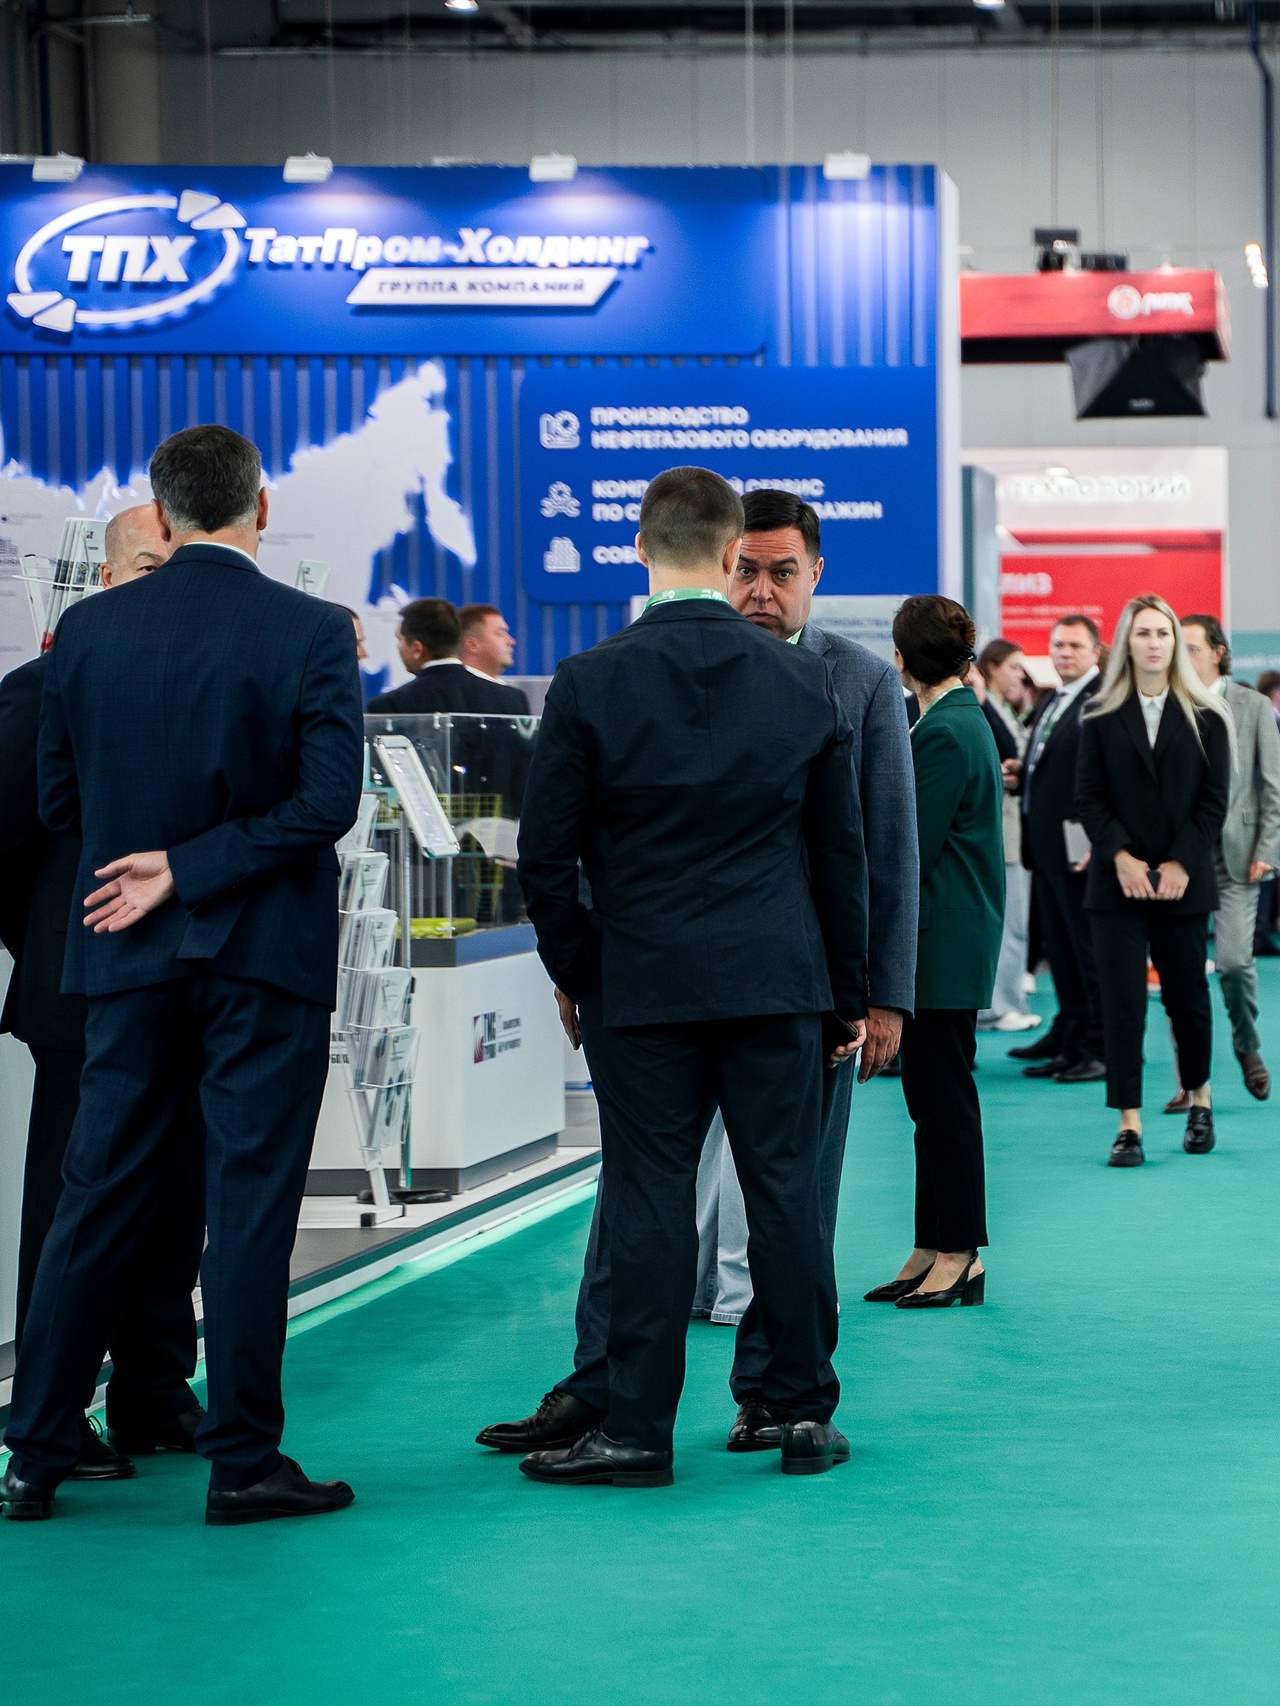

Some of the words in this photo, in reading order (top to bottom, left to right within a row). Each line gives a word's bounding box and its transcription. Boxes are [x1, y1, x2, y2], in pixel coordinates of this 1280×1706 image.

[61, 233, 198, 283] ТПХ
[244, 227, 650, 270] ТатПром-Холдинг
[378, 279, 460, 295] ГРУППА
[466, 277, 585, 294] КОМПАНИЙ
[590, 406, 750, 428] ПРОИЗВОДСТВО
[590, 429, 750, 449] НЕФТЕГАЗОВОГО
[750, 427, 909, 450] ОБОРУДОВАНИЯ
[592, 503, 624, 522] ПО
